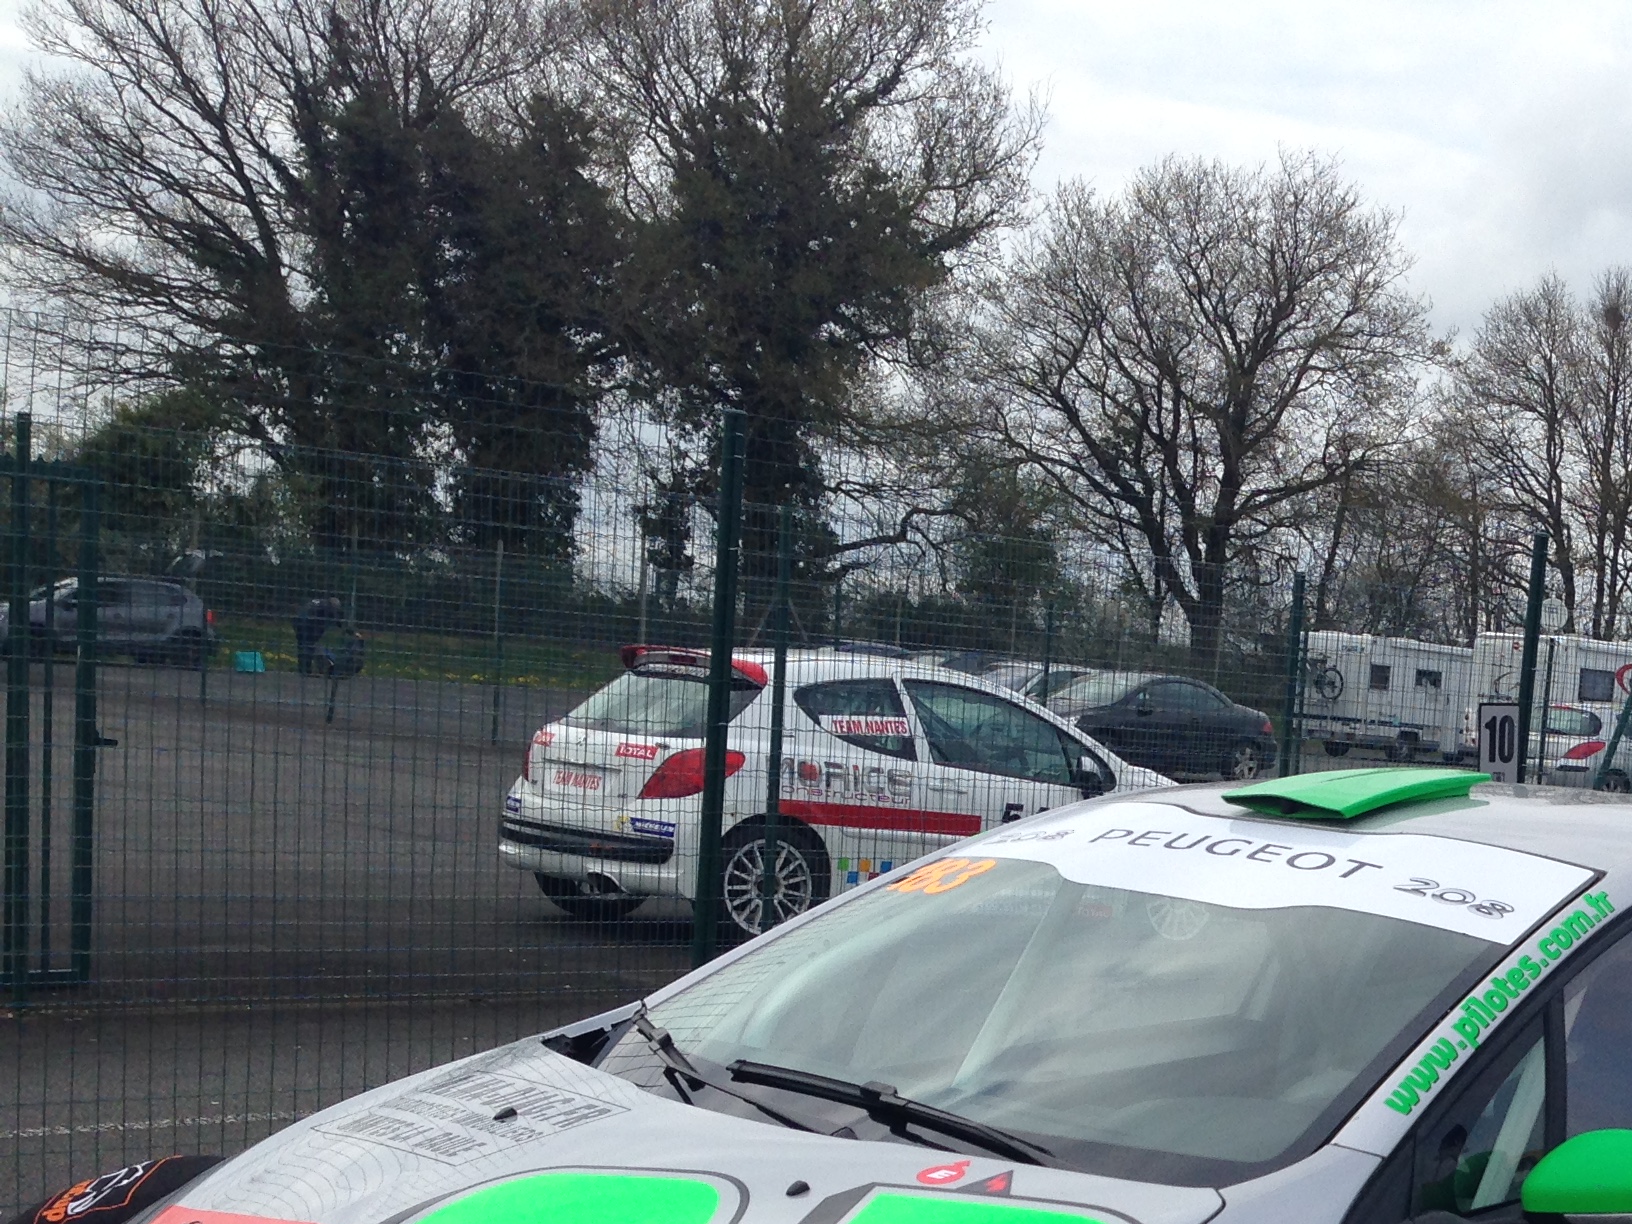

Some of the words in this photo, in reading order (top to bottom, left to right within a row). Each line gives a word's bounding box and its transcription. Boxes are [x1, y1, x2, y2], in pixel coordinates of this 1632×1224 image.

[831, 719, 863, 734] TEAM
[865, 720, 908, 735] NANTES
[1485, 715, 1515, 763] 10
[1089, 827, 1382, 881] PEUGEOT
[1393, 876, 1516, 921] 208
[1385, 889, 1617, 1116] www.pilotes.com.fr
